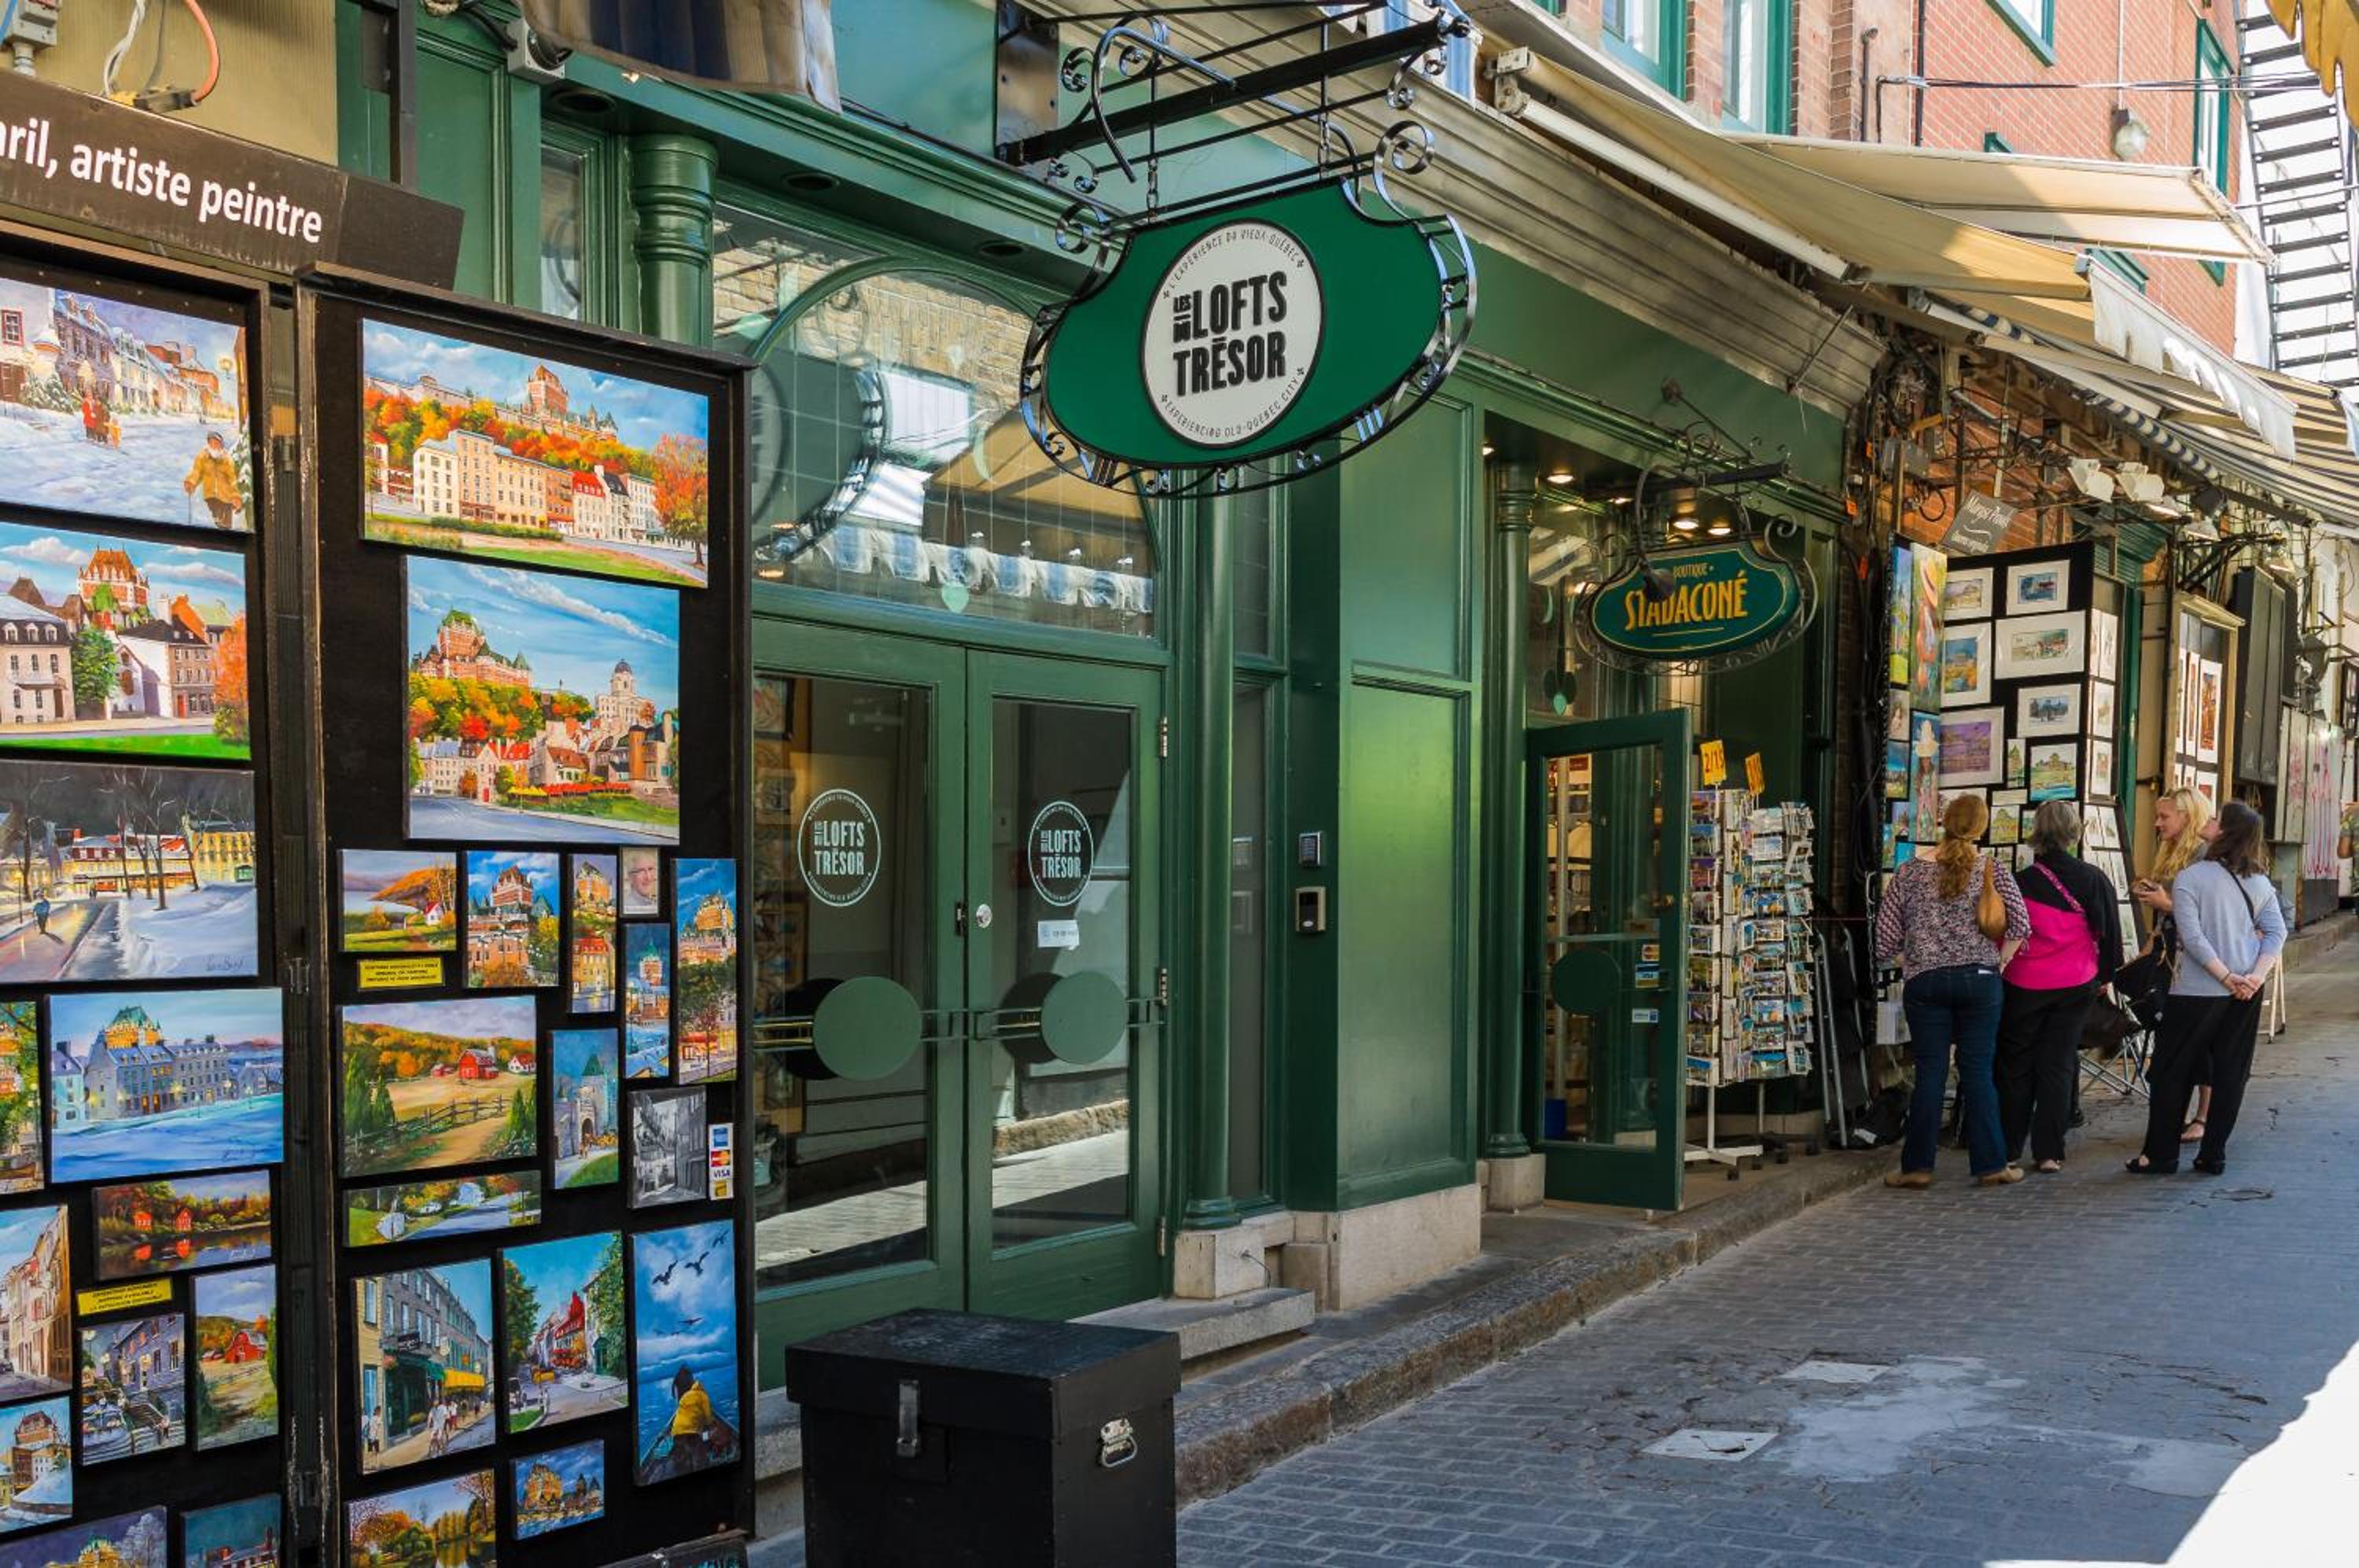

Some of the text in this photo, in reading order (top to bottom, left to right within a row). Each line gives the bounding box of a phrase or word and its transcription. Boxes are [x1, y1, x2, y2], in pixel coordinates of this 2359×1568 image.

[0, 117, 323, 245] ril, artiste peintre
[1172, 271, 1288, 340] LES LOFTS
[1172, 330, 1287, 397] TRÉSOR
[1280, 377, 1300, 403] CITY
[1673, 562, 1708, 579] BOUTIQUE
[1625, 569, 1750, 631] STADACONÉ
[823, 820, 865, 848] LOFTS
[1047, 830, 1081, 854] LOFTS
[814, 848, 865, 876] TRÉSOR
[1040, 853, 1081, 878] TRÉSOR
